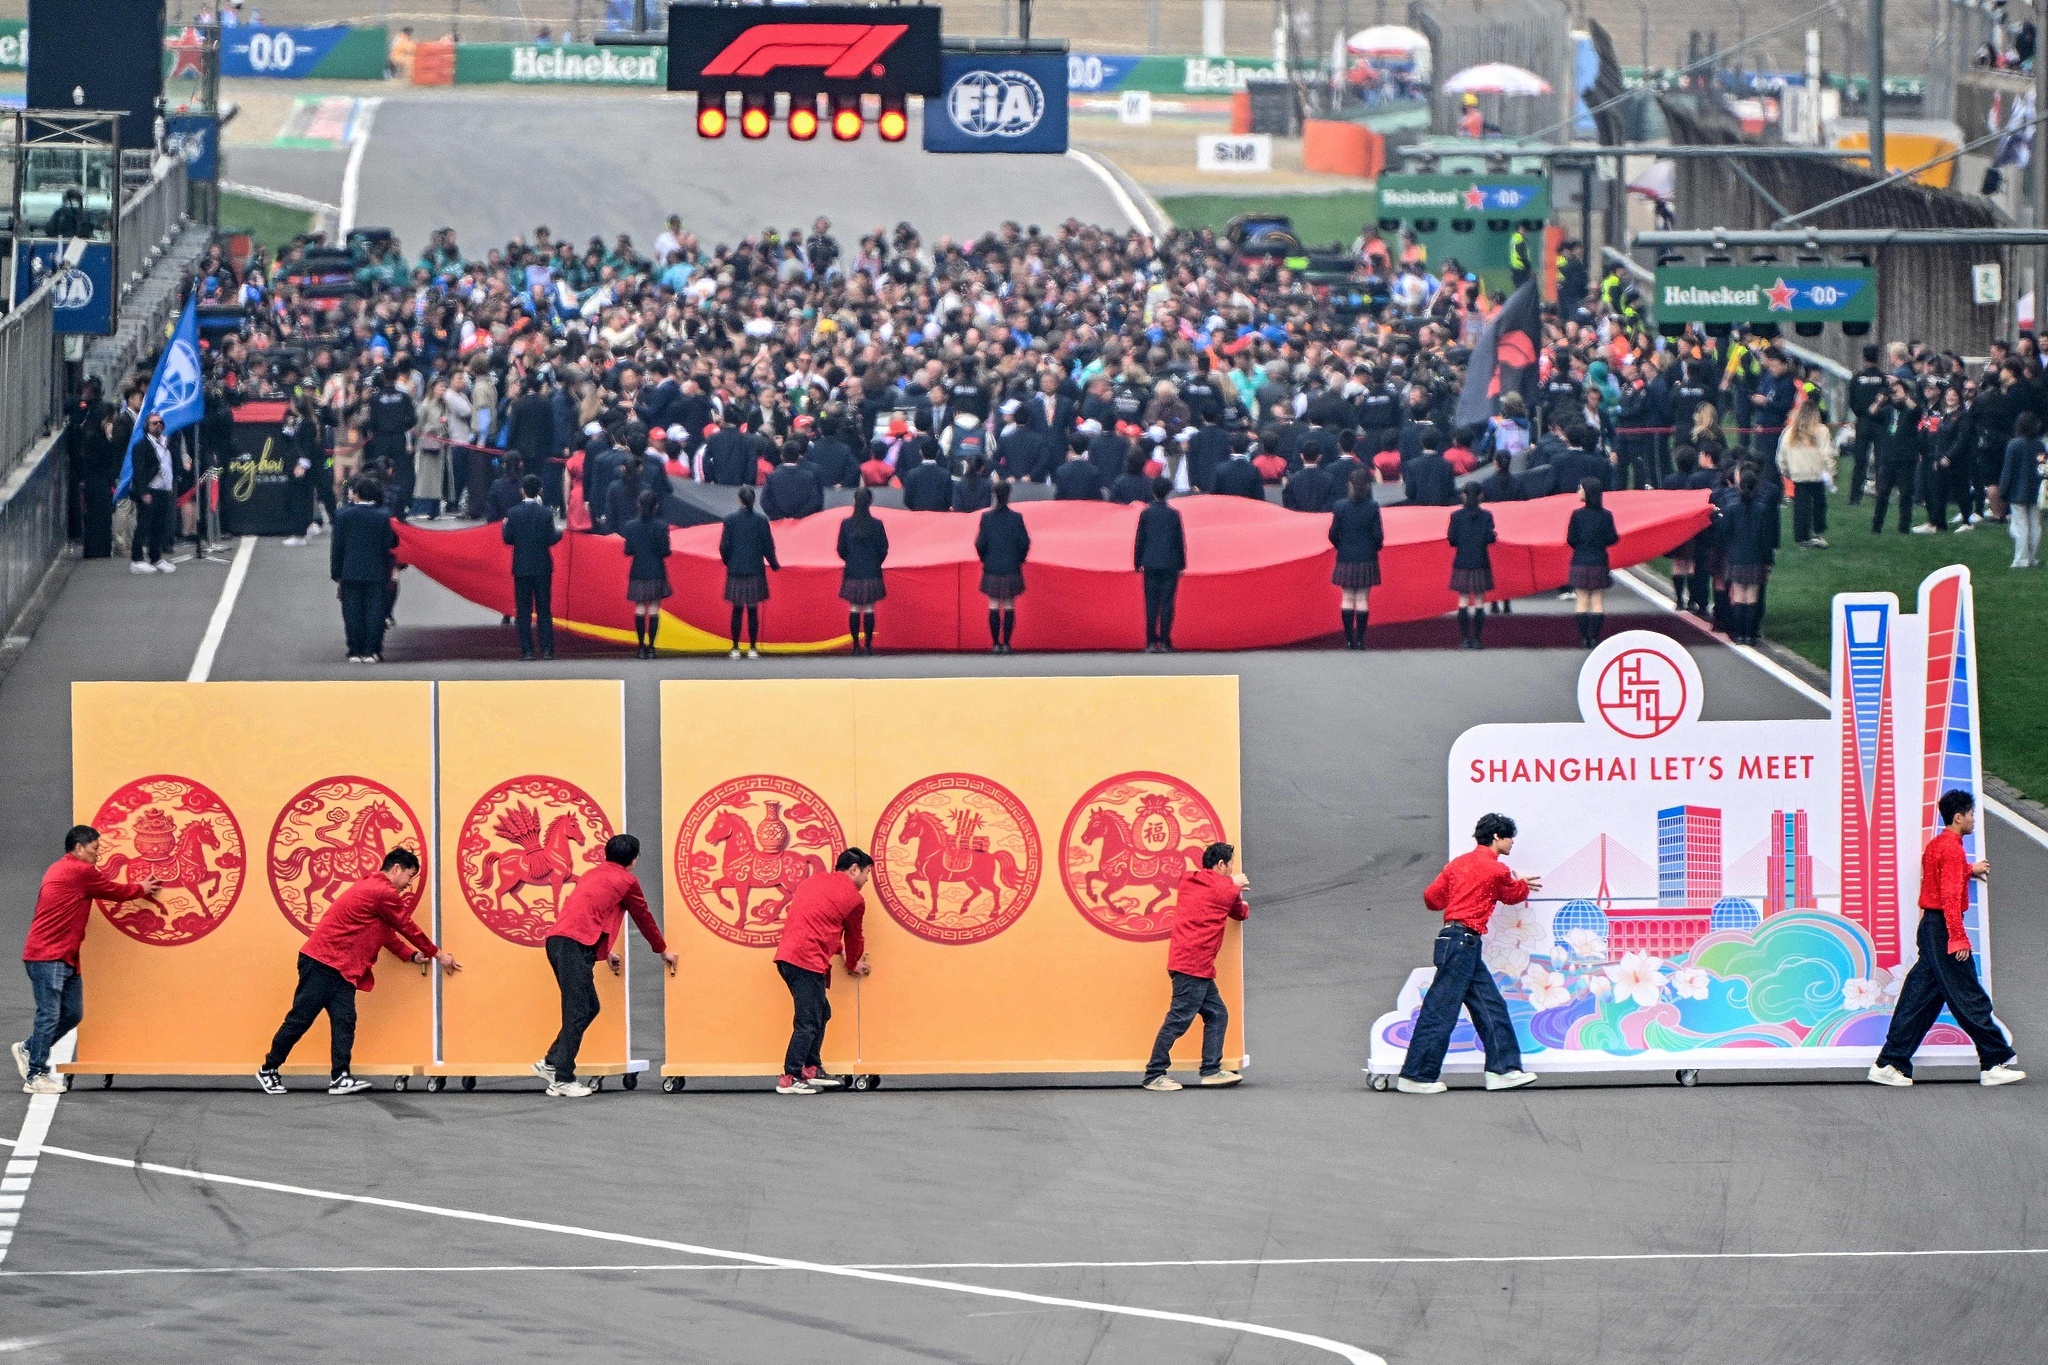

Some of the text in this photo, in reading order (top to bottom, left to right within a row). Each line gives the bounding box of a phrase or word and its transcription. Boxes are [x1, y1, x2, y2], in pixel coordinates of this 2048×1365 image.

[511, 47, 657, 80] Heineken
[1664, 286, 1760, 306] Heineken
[1470, 755, 1815, 783] SHANGHAI LET'S MEET
[1143, 822, 1167, 844] 福
